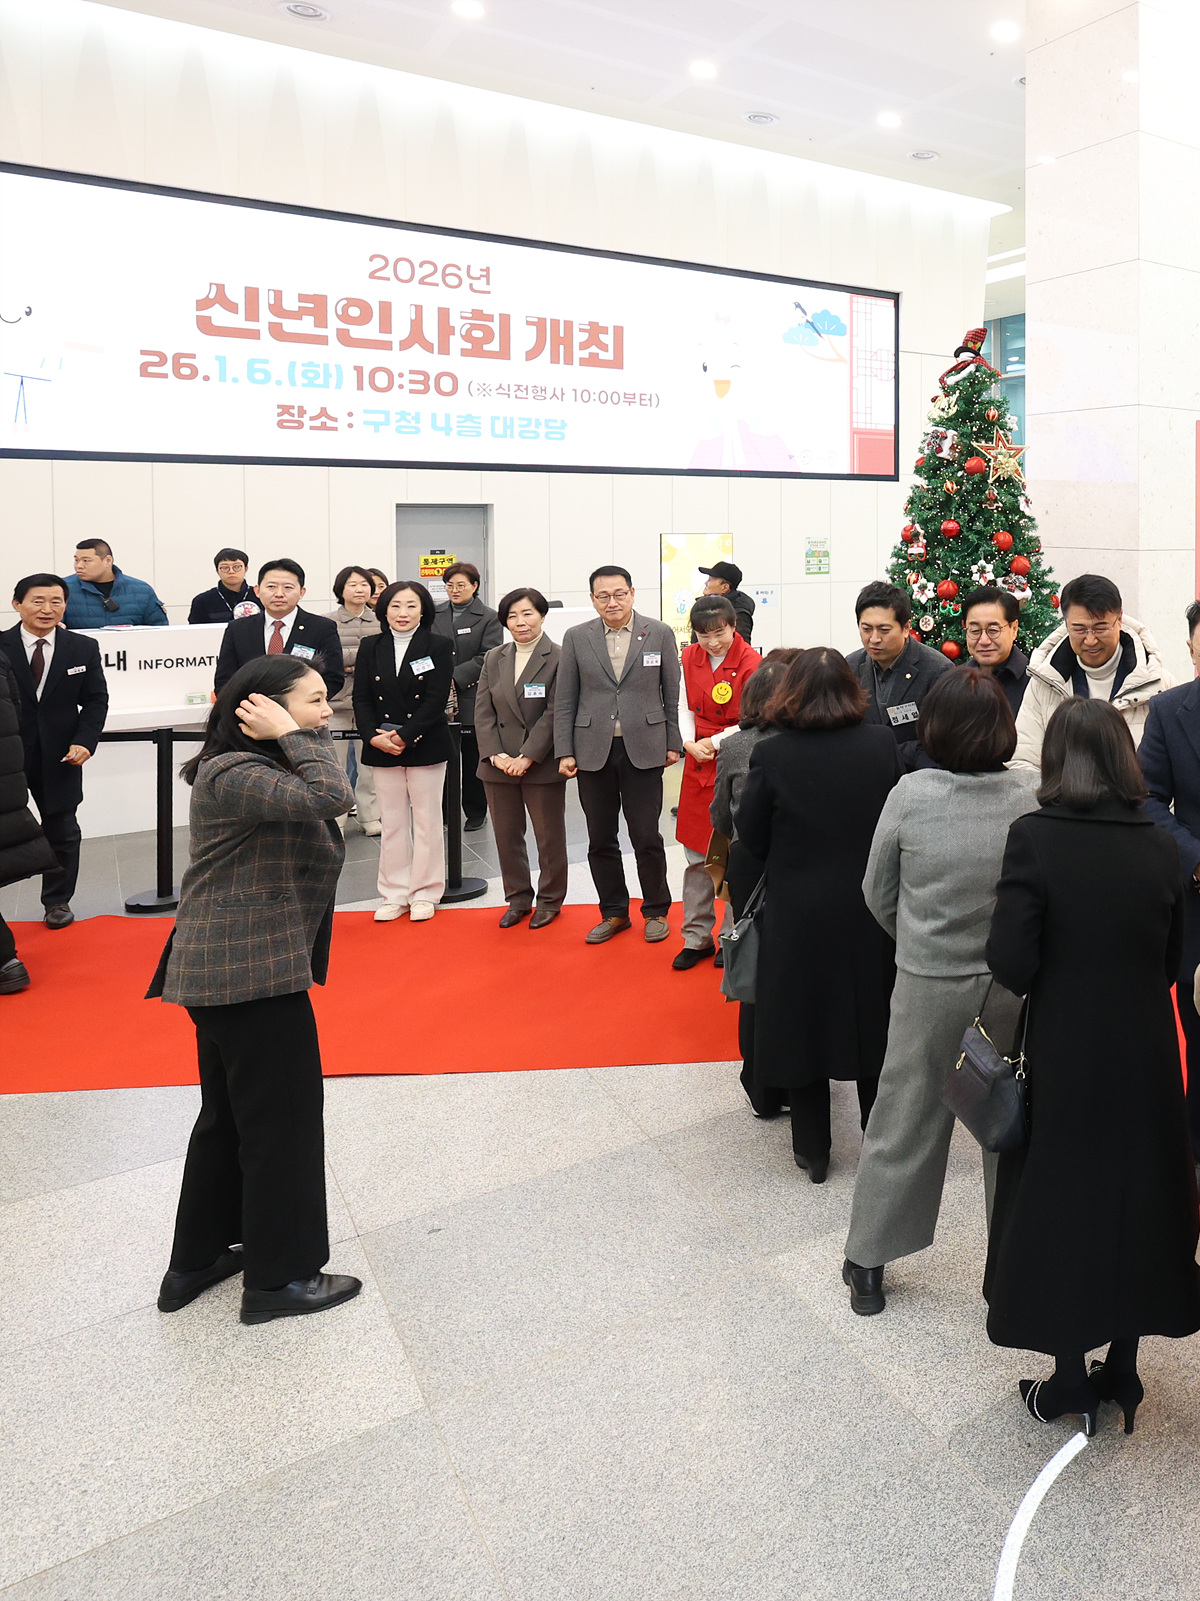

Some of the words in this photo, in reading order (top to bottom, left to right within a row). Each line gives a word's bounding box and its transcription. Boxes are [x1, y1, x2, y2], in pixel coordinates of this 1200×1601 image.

[367, 253, 492, 295] 2026년
[195, 281, 511, 360] 신년인사회
[525, 315, 624, 370] 개최
[353, 365, 459, 397] 10:30
[571, 388, 661, 408] 10:00부터)
[362, 409, 421, 435] 구청
[430, 411, 482, 438] 4층
[490, 415, 568, 441] 대강당
[672, 625, 693, 634] 어서오
